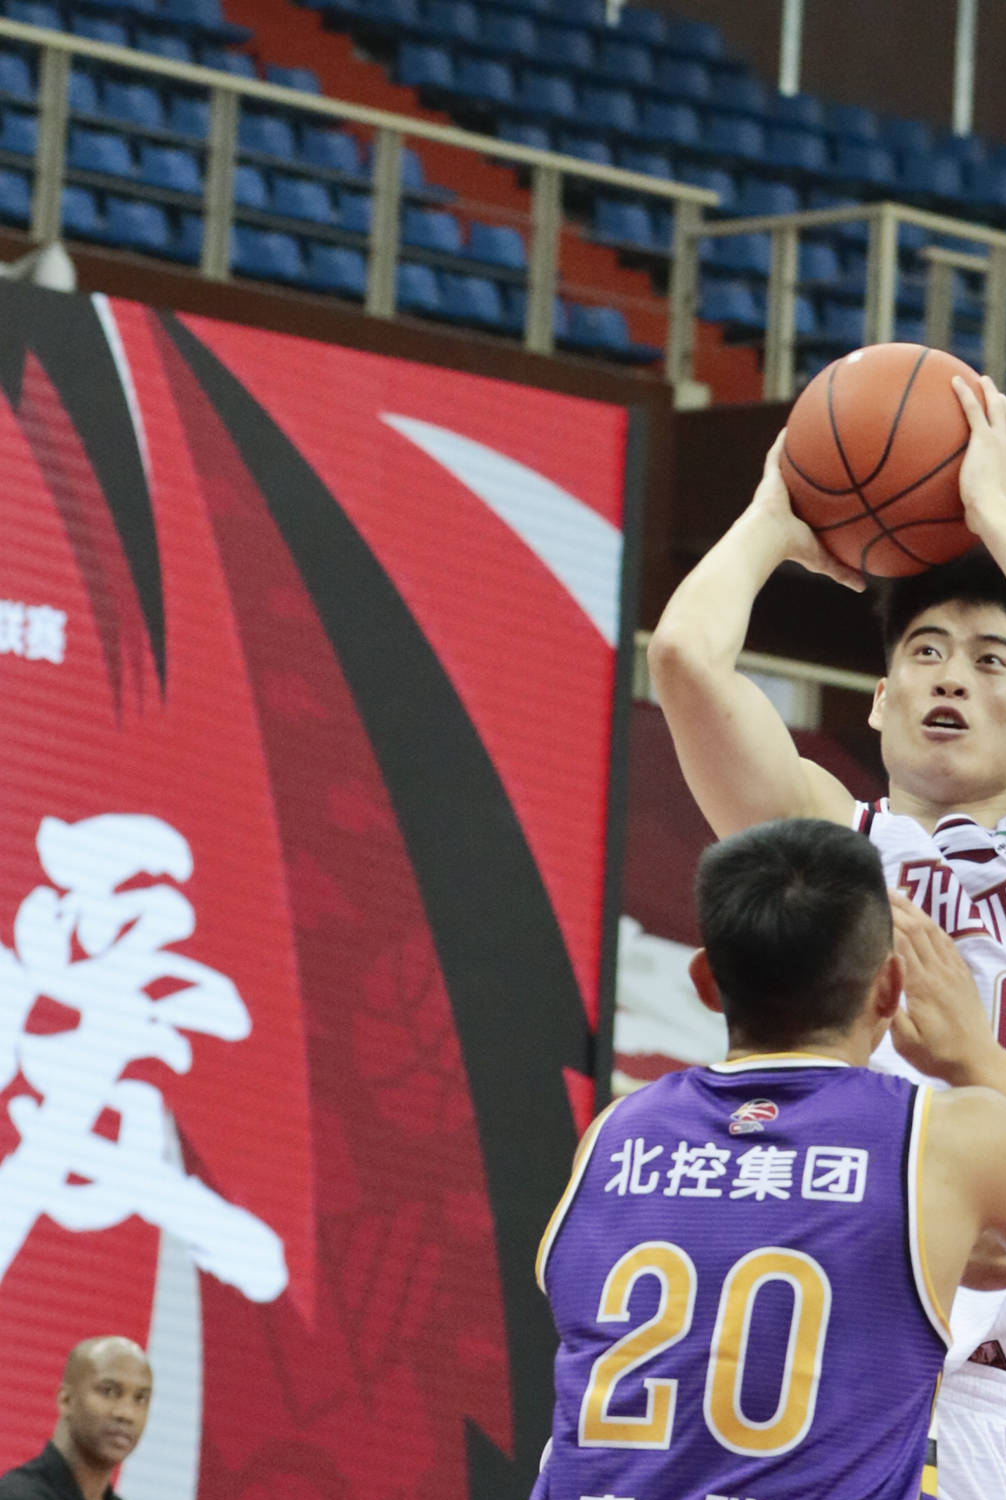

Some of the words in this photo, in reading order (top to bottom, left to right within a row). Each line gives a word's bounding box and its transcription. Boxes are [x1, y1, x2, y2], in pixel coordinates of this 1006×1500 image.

[603, 1137, 869, 1203] 北控集团
[577, 1240, 833, 1458] 20
